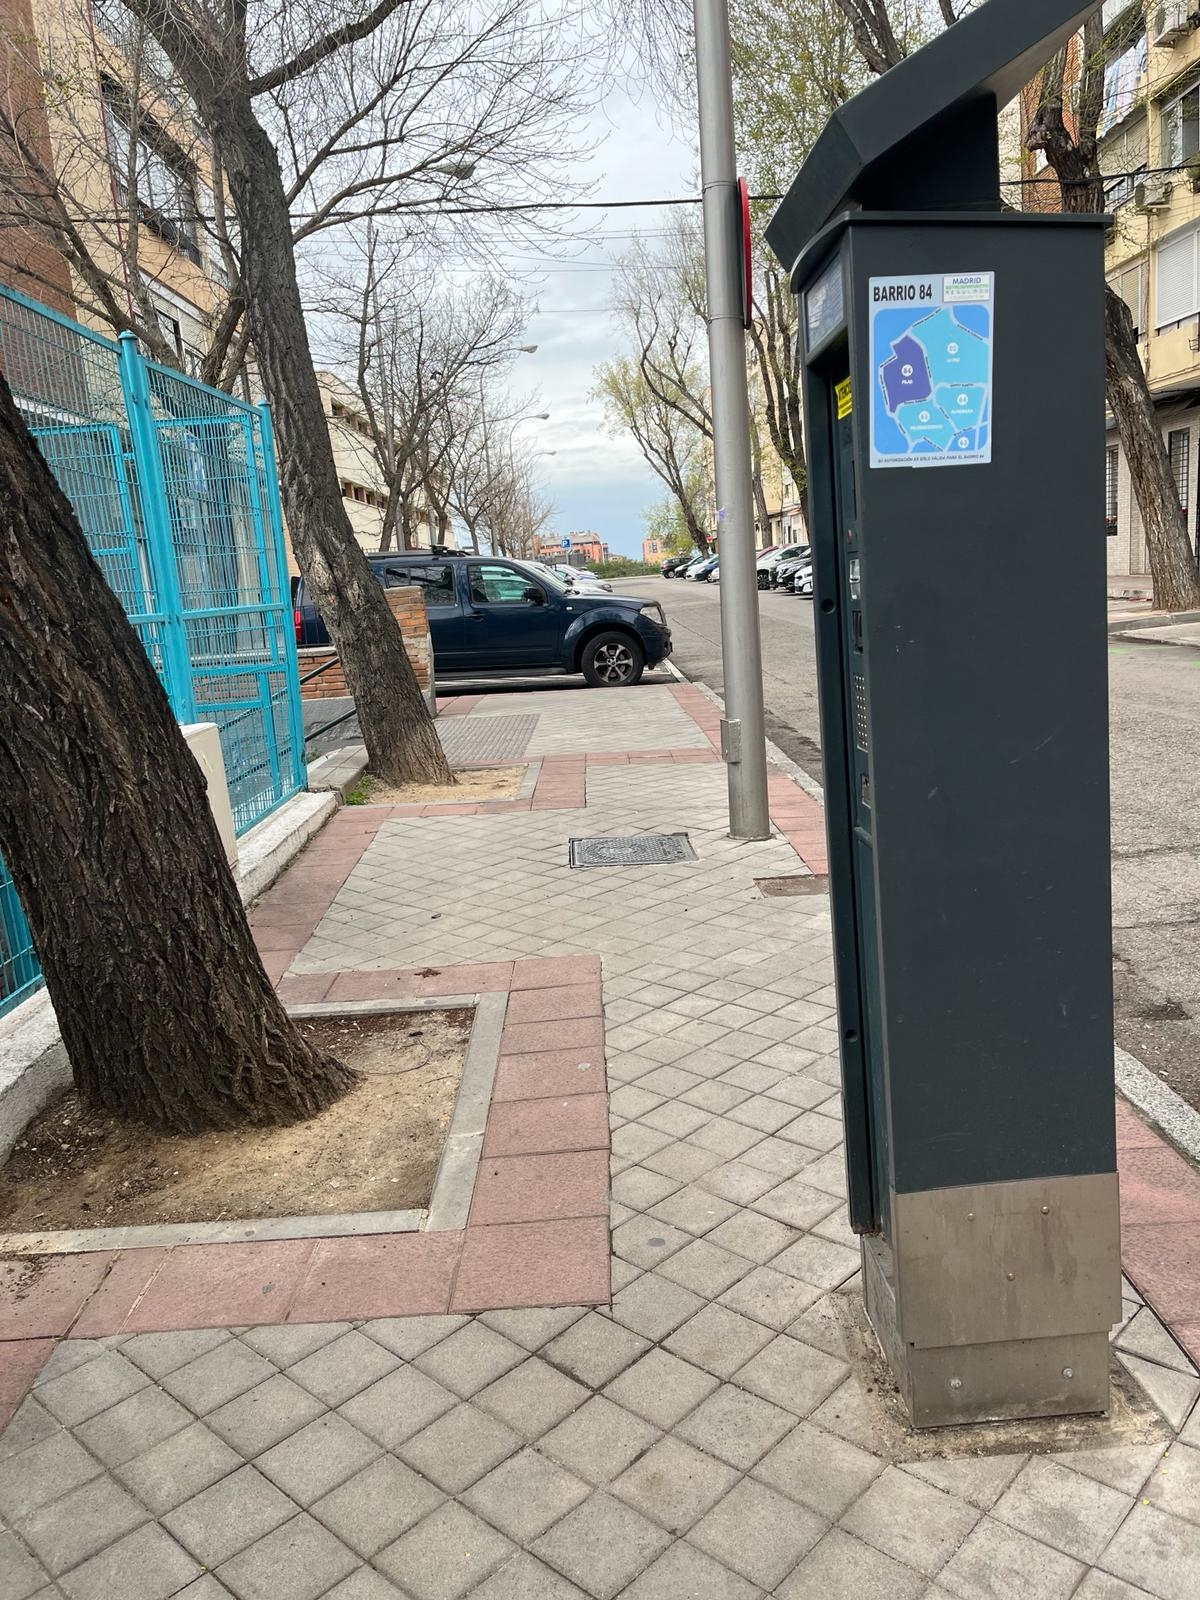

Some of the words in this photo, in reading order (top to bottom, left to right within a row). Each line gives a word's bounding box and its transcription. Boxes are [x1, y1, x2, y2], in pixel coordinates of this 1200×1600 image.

[952, 277, 982, 285] MADRID
[873, 284, 916, 302] BARRIO
[919, 283, 933, 300] 84
